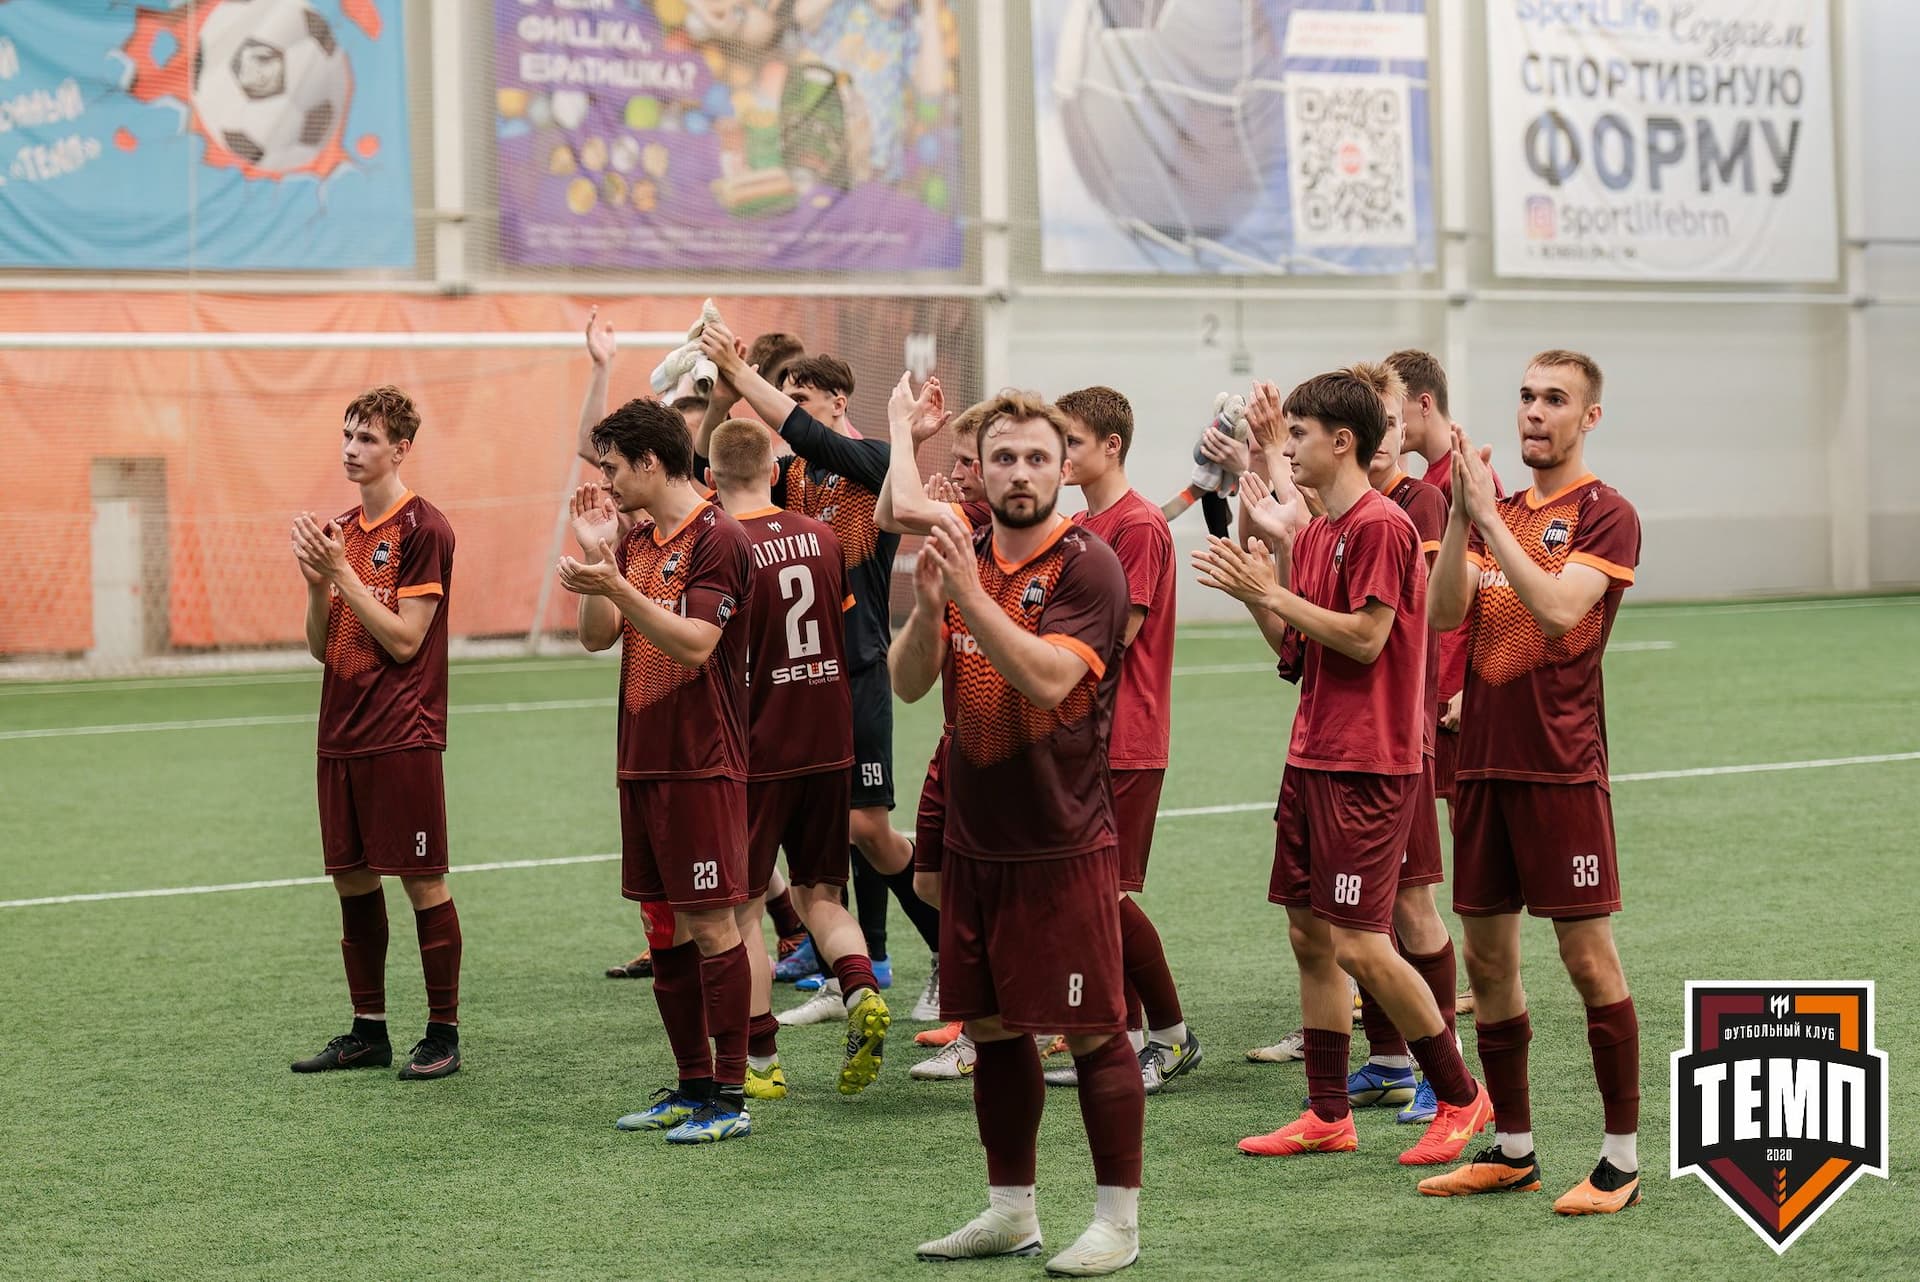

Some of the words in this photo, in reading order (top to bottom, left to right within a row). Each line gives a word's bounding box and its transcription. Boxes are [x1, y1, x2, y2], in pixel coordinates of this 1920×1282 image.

[1522, 53, 1804, 107] СПОРТИВНУЮ
[1525, 110, 1802, 196] ФОРМУ
[778, 564, 821, 659] 2
[771, 659, 839, 684] SEUS
[861, 763, 883, 786] 59
[415, 831, 427, 857] 3
[693, 861, 718, 890] 23
[1572, 854, 1600, 887] 33
[1334, 873, 1362, 906] 88
[1068, 972, 1084, 1007] 8
